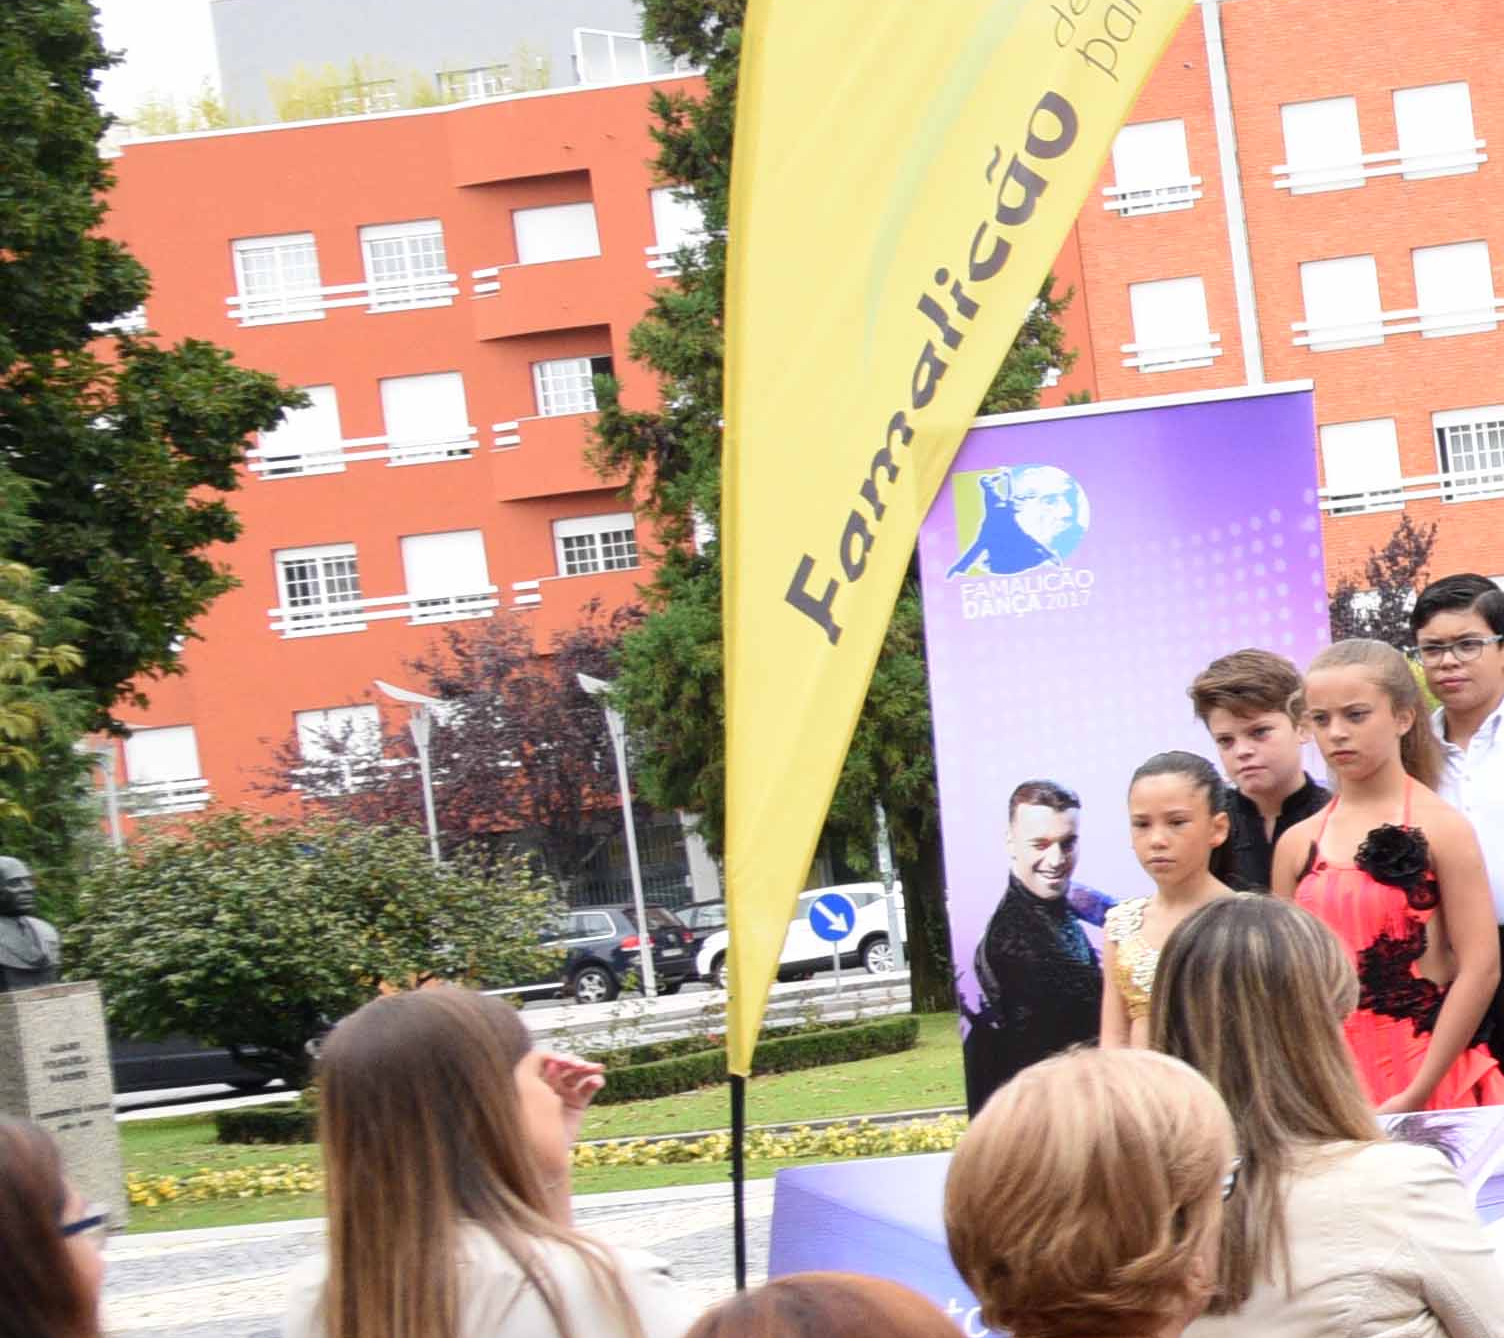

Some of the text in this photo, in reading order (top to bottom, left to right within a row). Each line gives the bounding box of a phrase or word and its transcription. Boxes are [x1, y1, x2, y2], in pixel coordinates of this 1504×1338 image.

[784, 91, 1079, 646] Famalicão
[960, 566, 1095, 603] FAMALICÃO
[962, 593, 1041, 620] DANÇA
